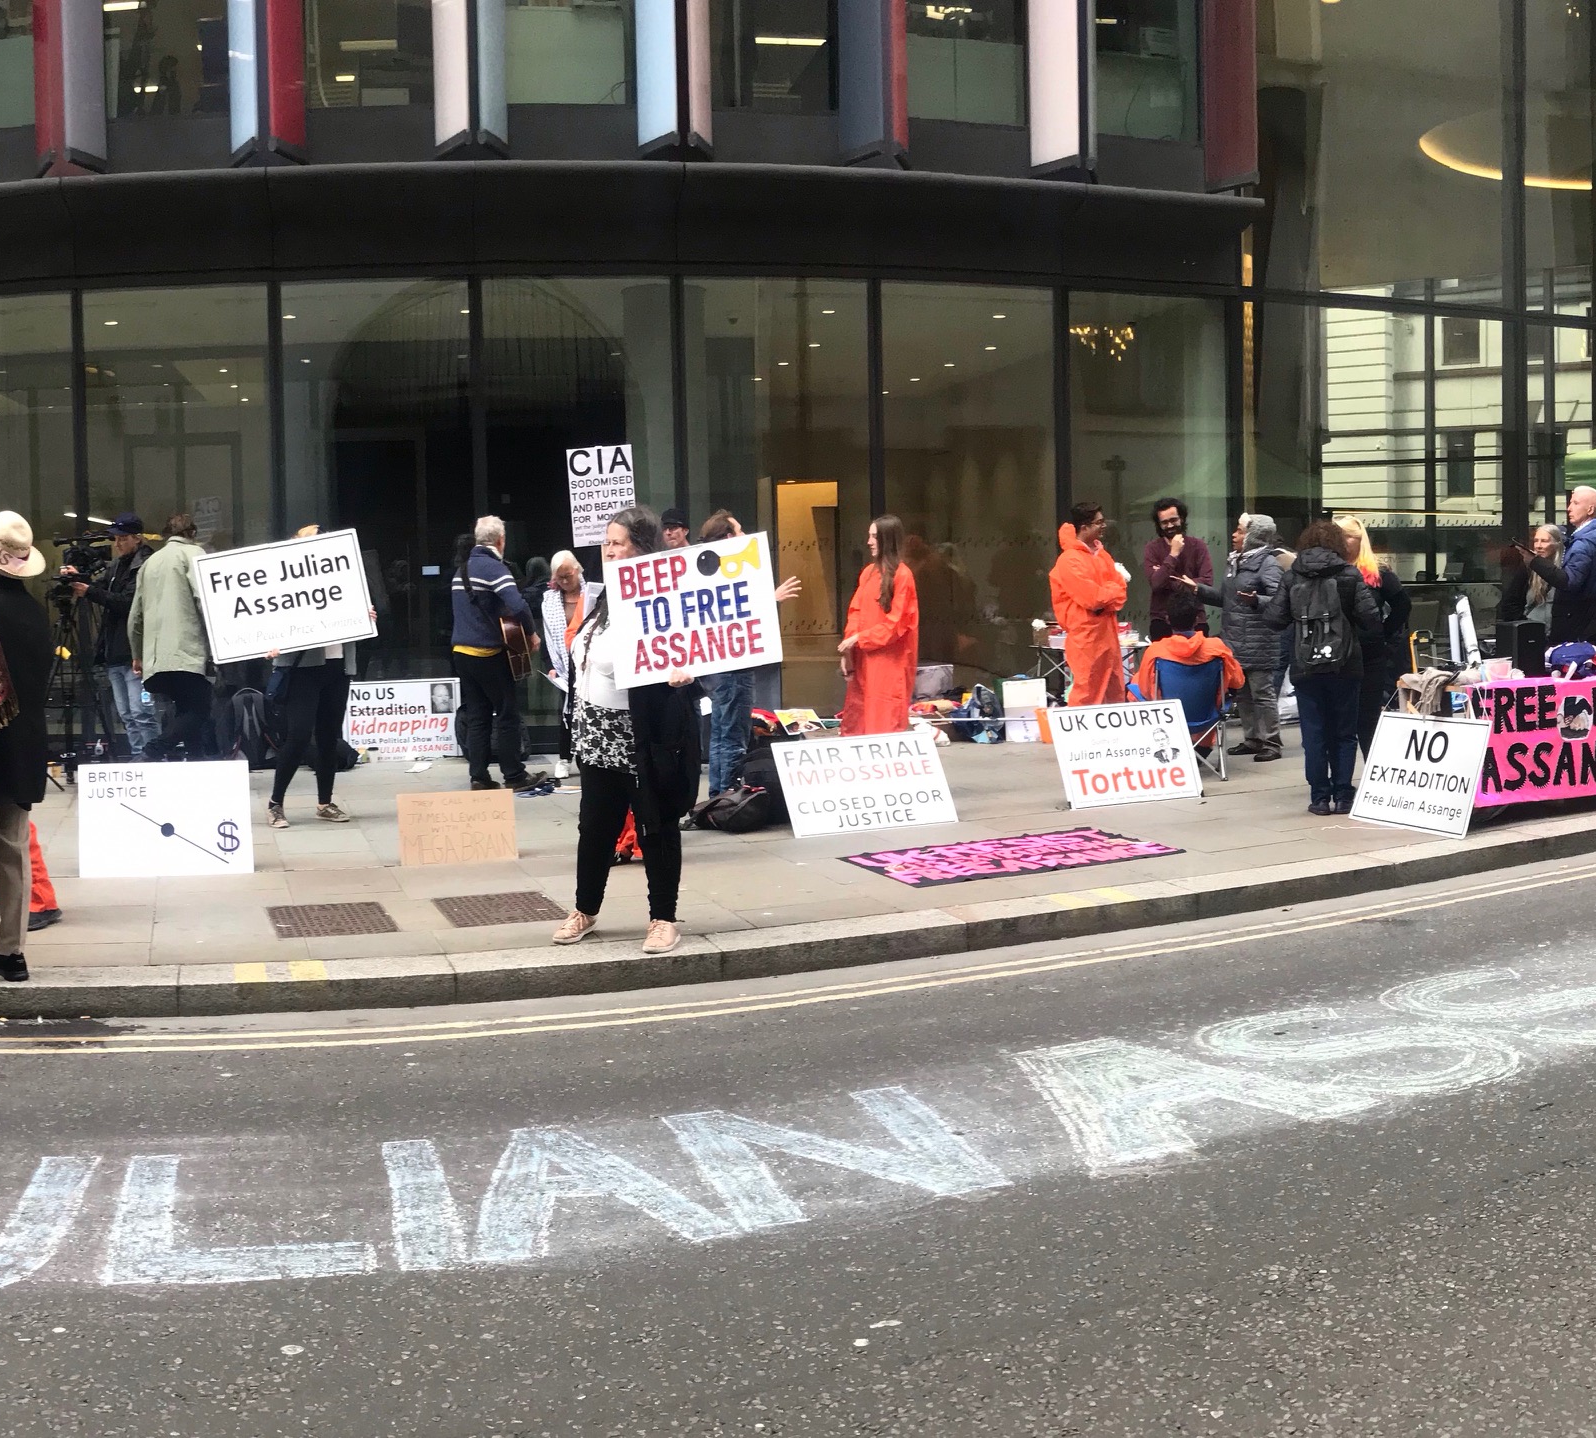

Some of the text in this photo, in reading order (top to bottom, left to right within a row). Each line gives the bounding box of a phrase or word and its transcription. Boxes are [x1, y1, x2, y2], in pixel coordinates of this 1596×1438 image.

[569, 446, 632, 477] CIA
[570, 475, 633, 489] SODOMISED
[572, 487, 634, 501] TORTURED
[572, 499, 635, 514] AND BEAT ME
[573, 515, 592, 524] FOR
[210, 554, 350, 593] Free Julian
[618, 555, 687, 601] BEEP
[233, 584, 343, 618] Assange
[635, 580, 752, 635] TO FREE
[256, 630, 285, 643] Peace
[289, 624, 315, 637] Prize
[634, 618, 765, 675] ASSANGE
[350, 687, 395, 701] No US
[350, 703, 426, 716] Extradition
[1059, 707, 1174, 732] UK COURTS
[1471, 684, 1558, 734] FREE
[350, 715, 449, 736] kidnapping
[379, 736, 410, 744] Political
[379, 743, 454, 754] ULIAN ASSANGE
[1404, 729, 1449, 763] NO
[783, 740, 928, 768] FAIR TRIAL
[1069, 746, 1151, 762] Julian Assange
[88, 771, 144, 783] BRITISH
[788, 759, 934, 787] IMPOSSIBLE
[1071, 766, 1186, 796] Torture
[1369, 765, 1471, 794] EXTRADITION
[88, 786, 147, 799] JUSTICE
[797, 789, 944, 815] CLOSED DOOR
[838, 808, 916, 828] JUSTICE
[1363, 791, 1462, 820] Free Julian Assange
[936, 829, 1111, 859] RESIST
[885, 859, 1009, 884] FREE
